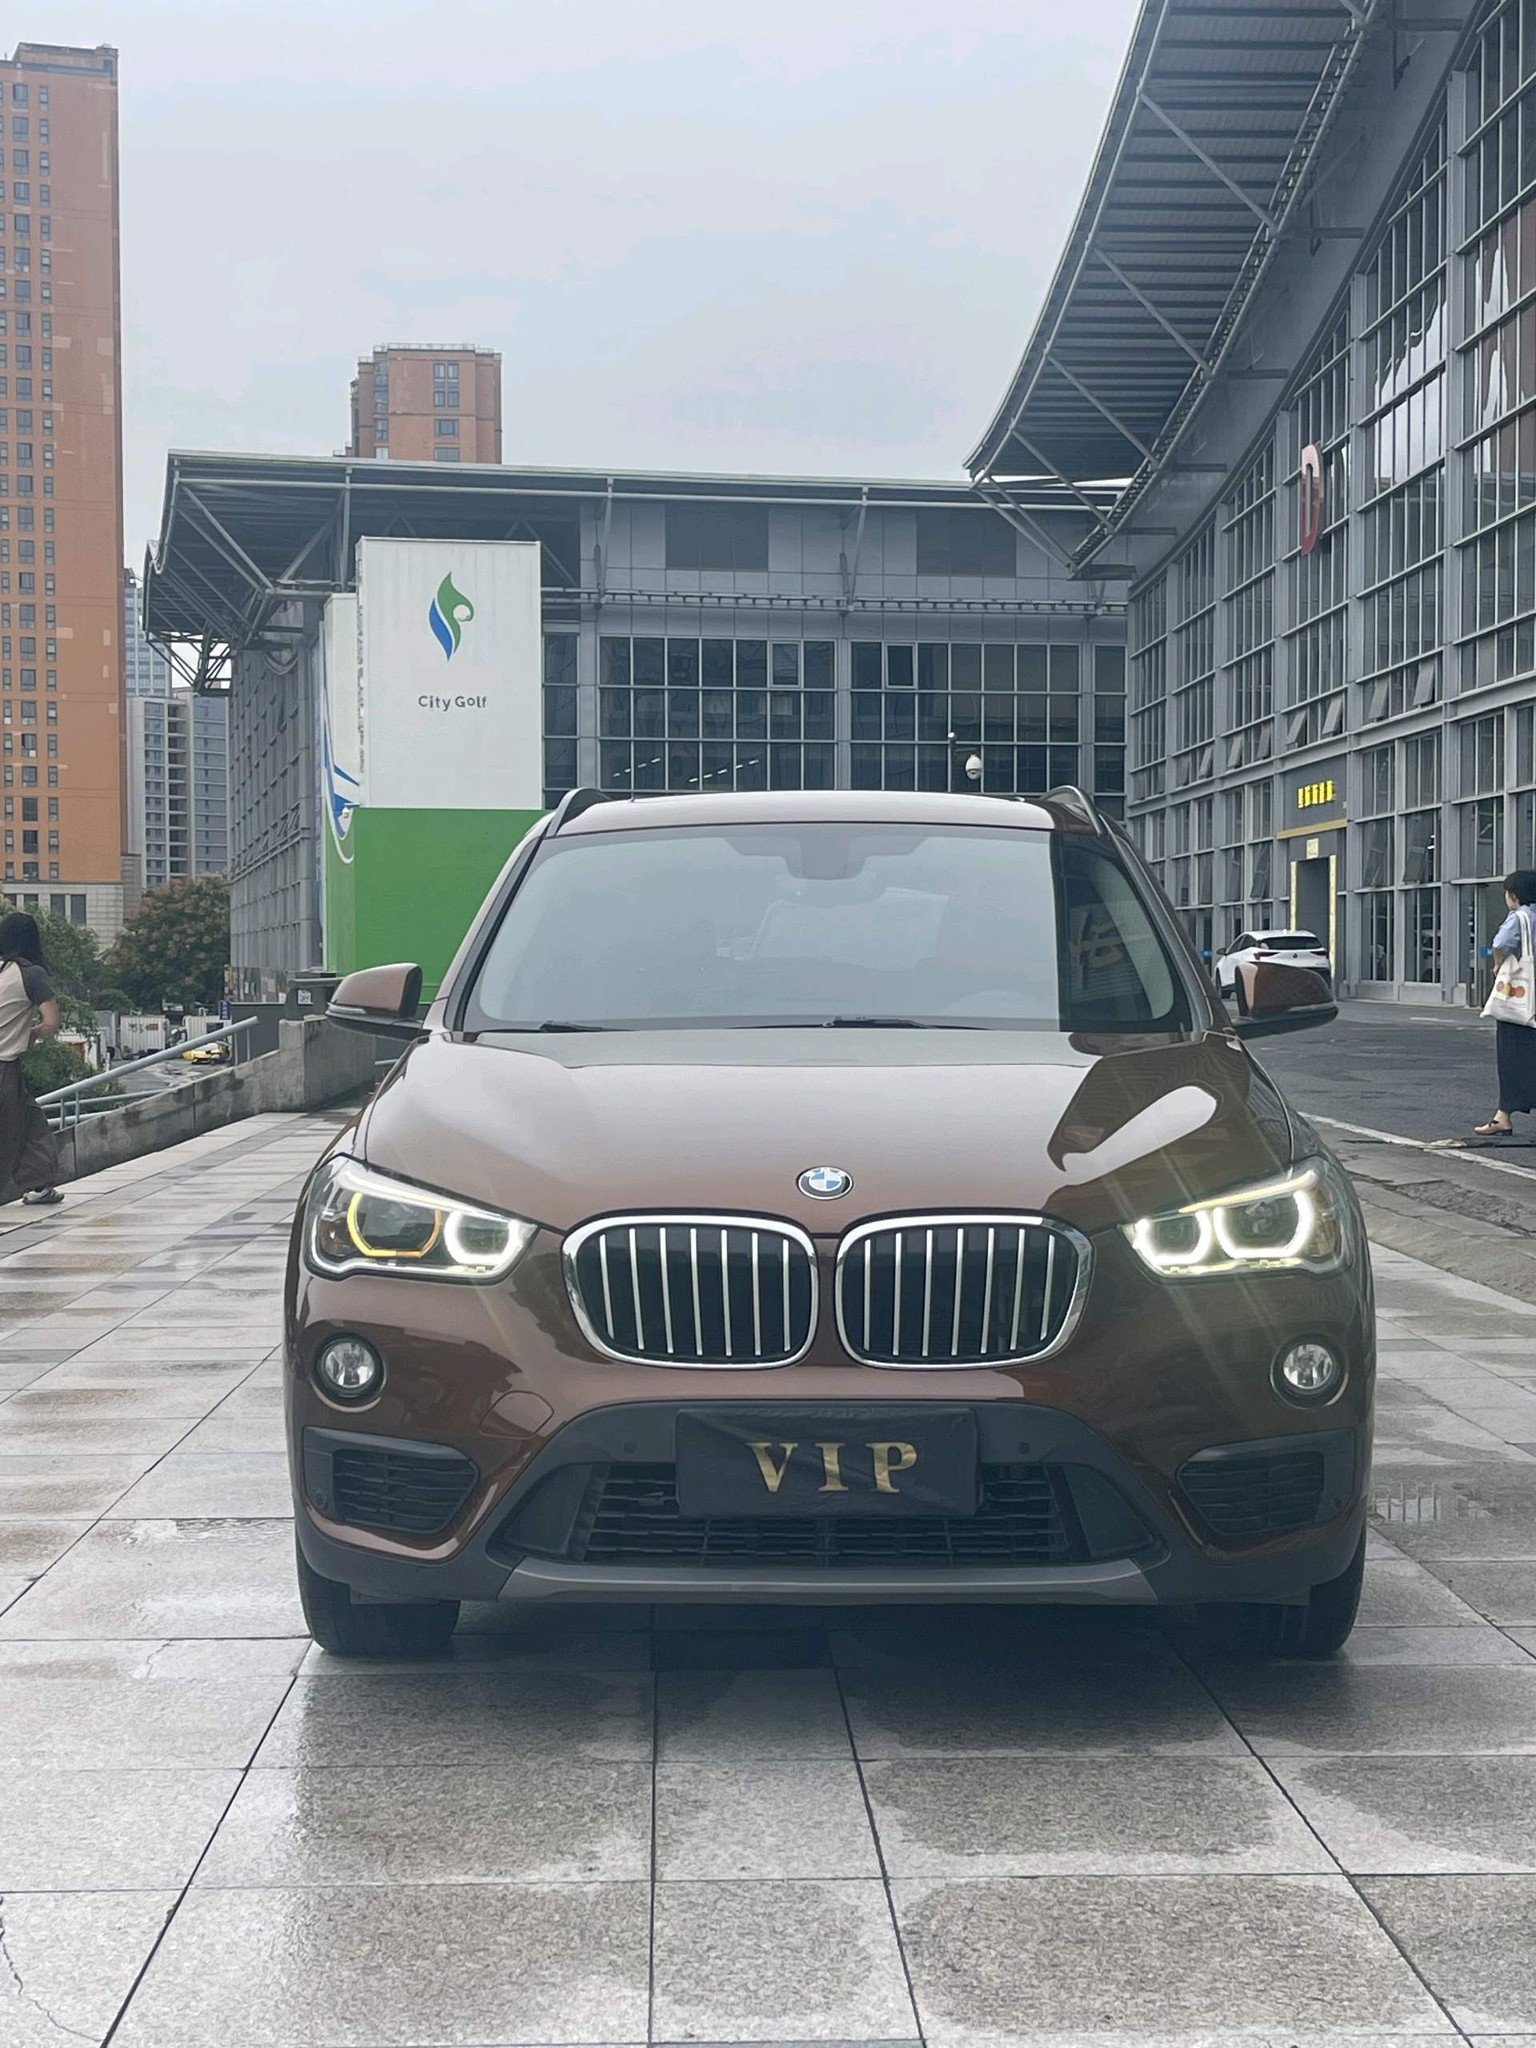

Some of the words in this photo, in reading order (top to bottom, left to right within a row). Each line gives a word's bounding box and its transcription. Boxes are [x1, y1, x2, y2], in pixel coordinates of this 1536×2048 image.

[418, 695, 451, 712] City
[454, 695, 487, 709] Golf
[745, 1441, 918, 1493] VIP
